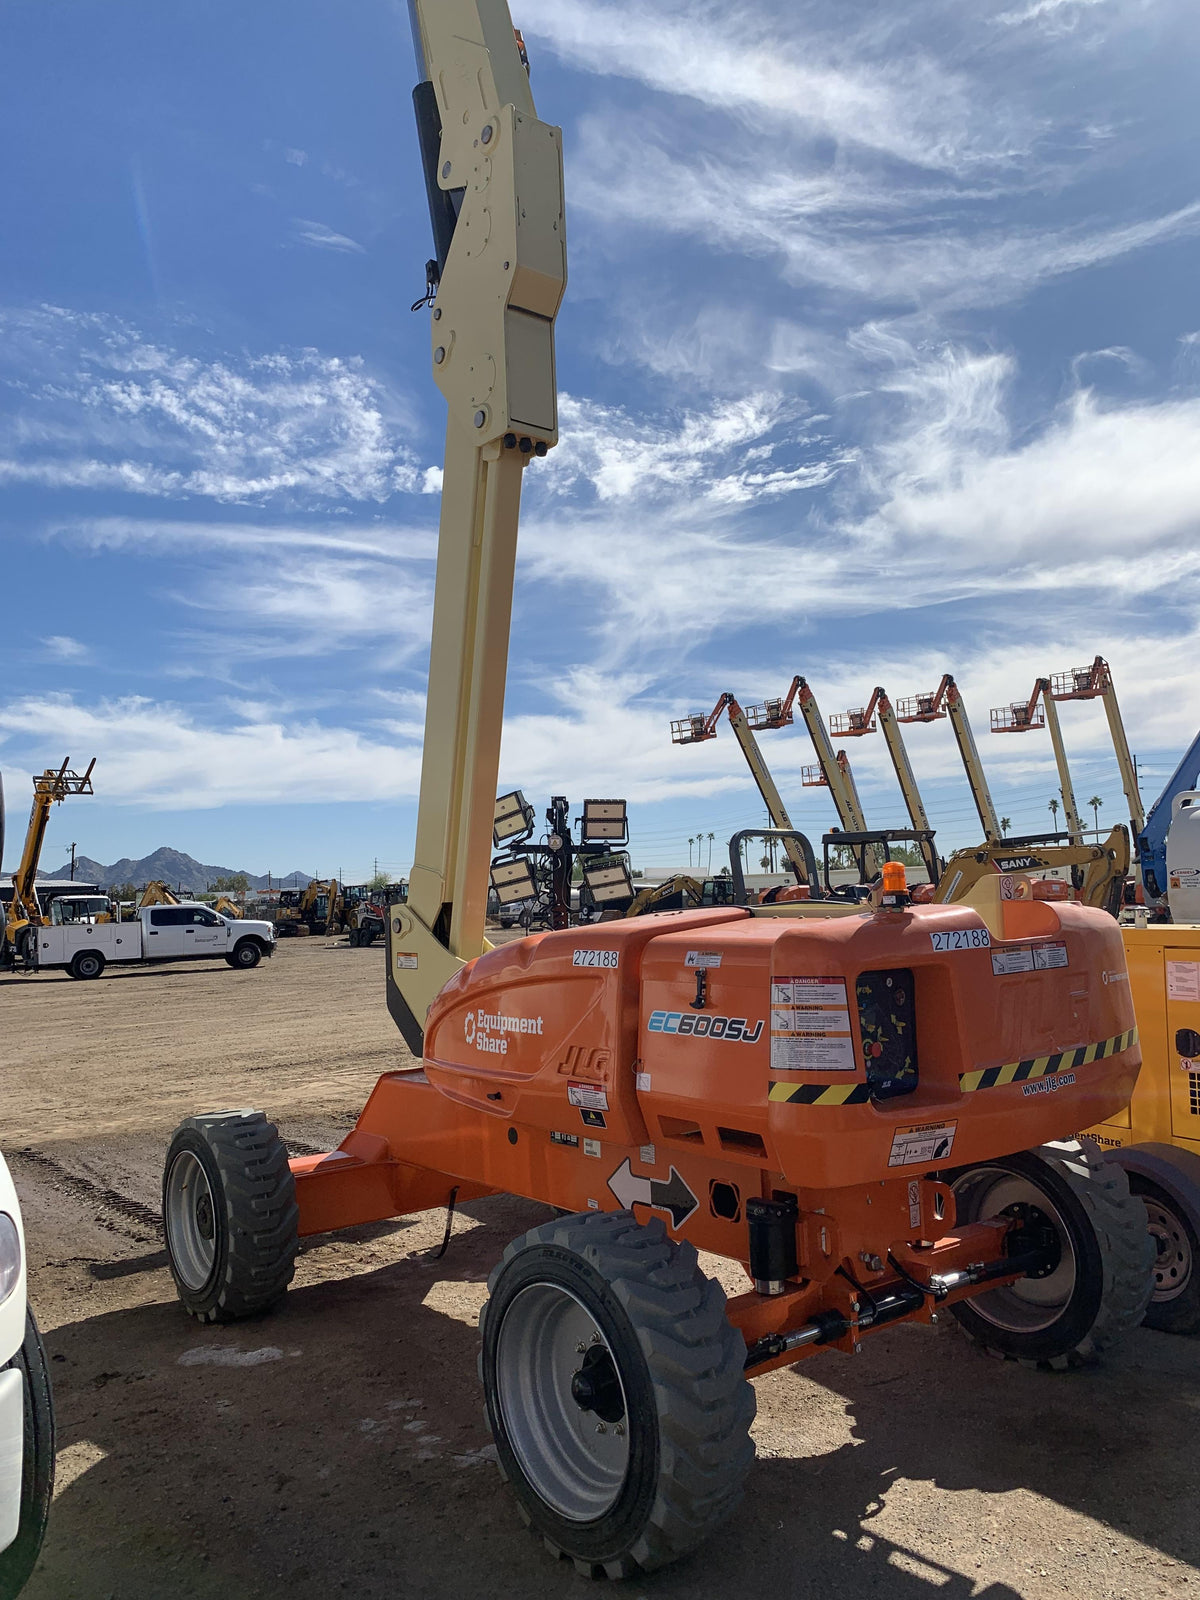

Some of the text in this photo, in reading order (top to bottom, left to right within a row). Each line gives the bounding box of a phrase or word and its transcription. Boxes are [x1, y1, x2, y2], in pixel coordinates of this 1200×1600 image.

[845, 799, 853, 813] JLG
[780, 810, 788, 822] JLG
[1000, 857, 1031, 870] SANY
[932, 929, 990, 951] 272188
[573, 950, 618, 967] 272188
[476, 1009, 544, 1035] Equipment
[648, 1010, 765, 1043] EC600SJ
[476, 1032, 508, 1055] Share
[557, 1045, 612, 1080] JLG
[1022, 1073, 1076, 1096] www.jlg.com
[915, 1123, 946, 1133] WARNING
[1071, 1131, 1122, 1148] entShare
